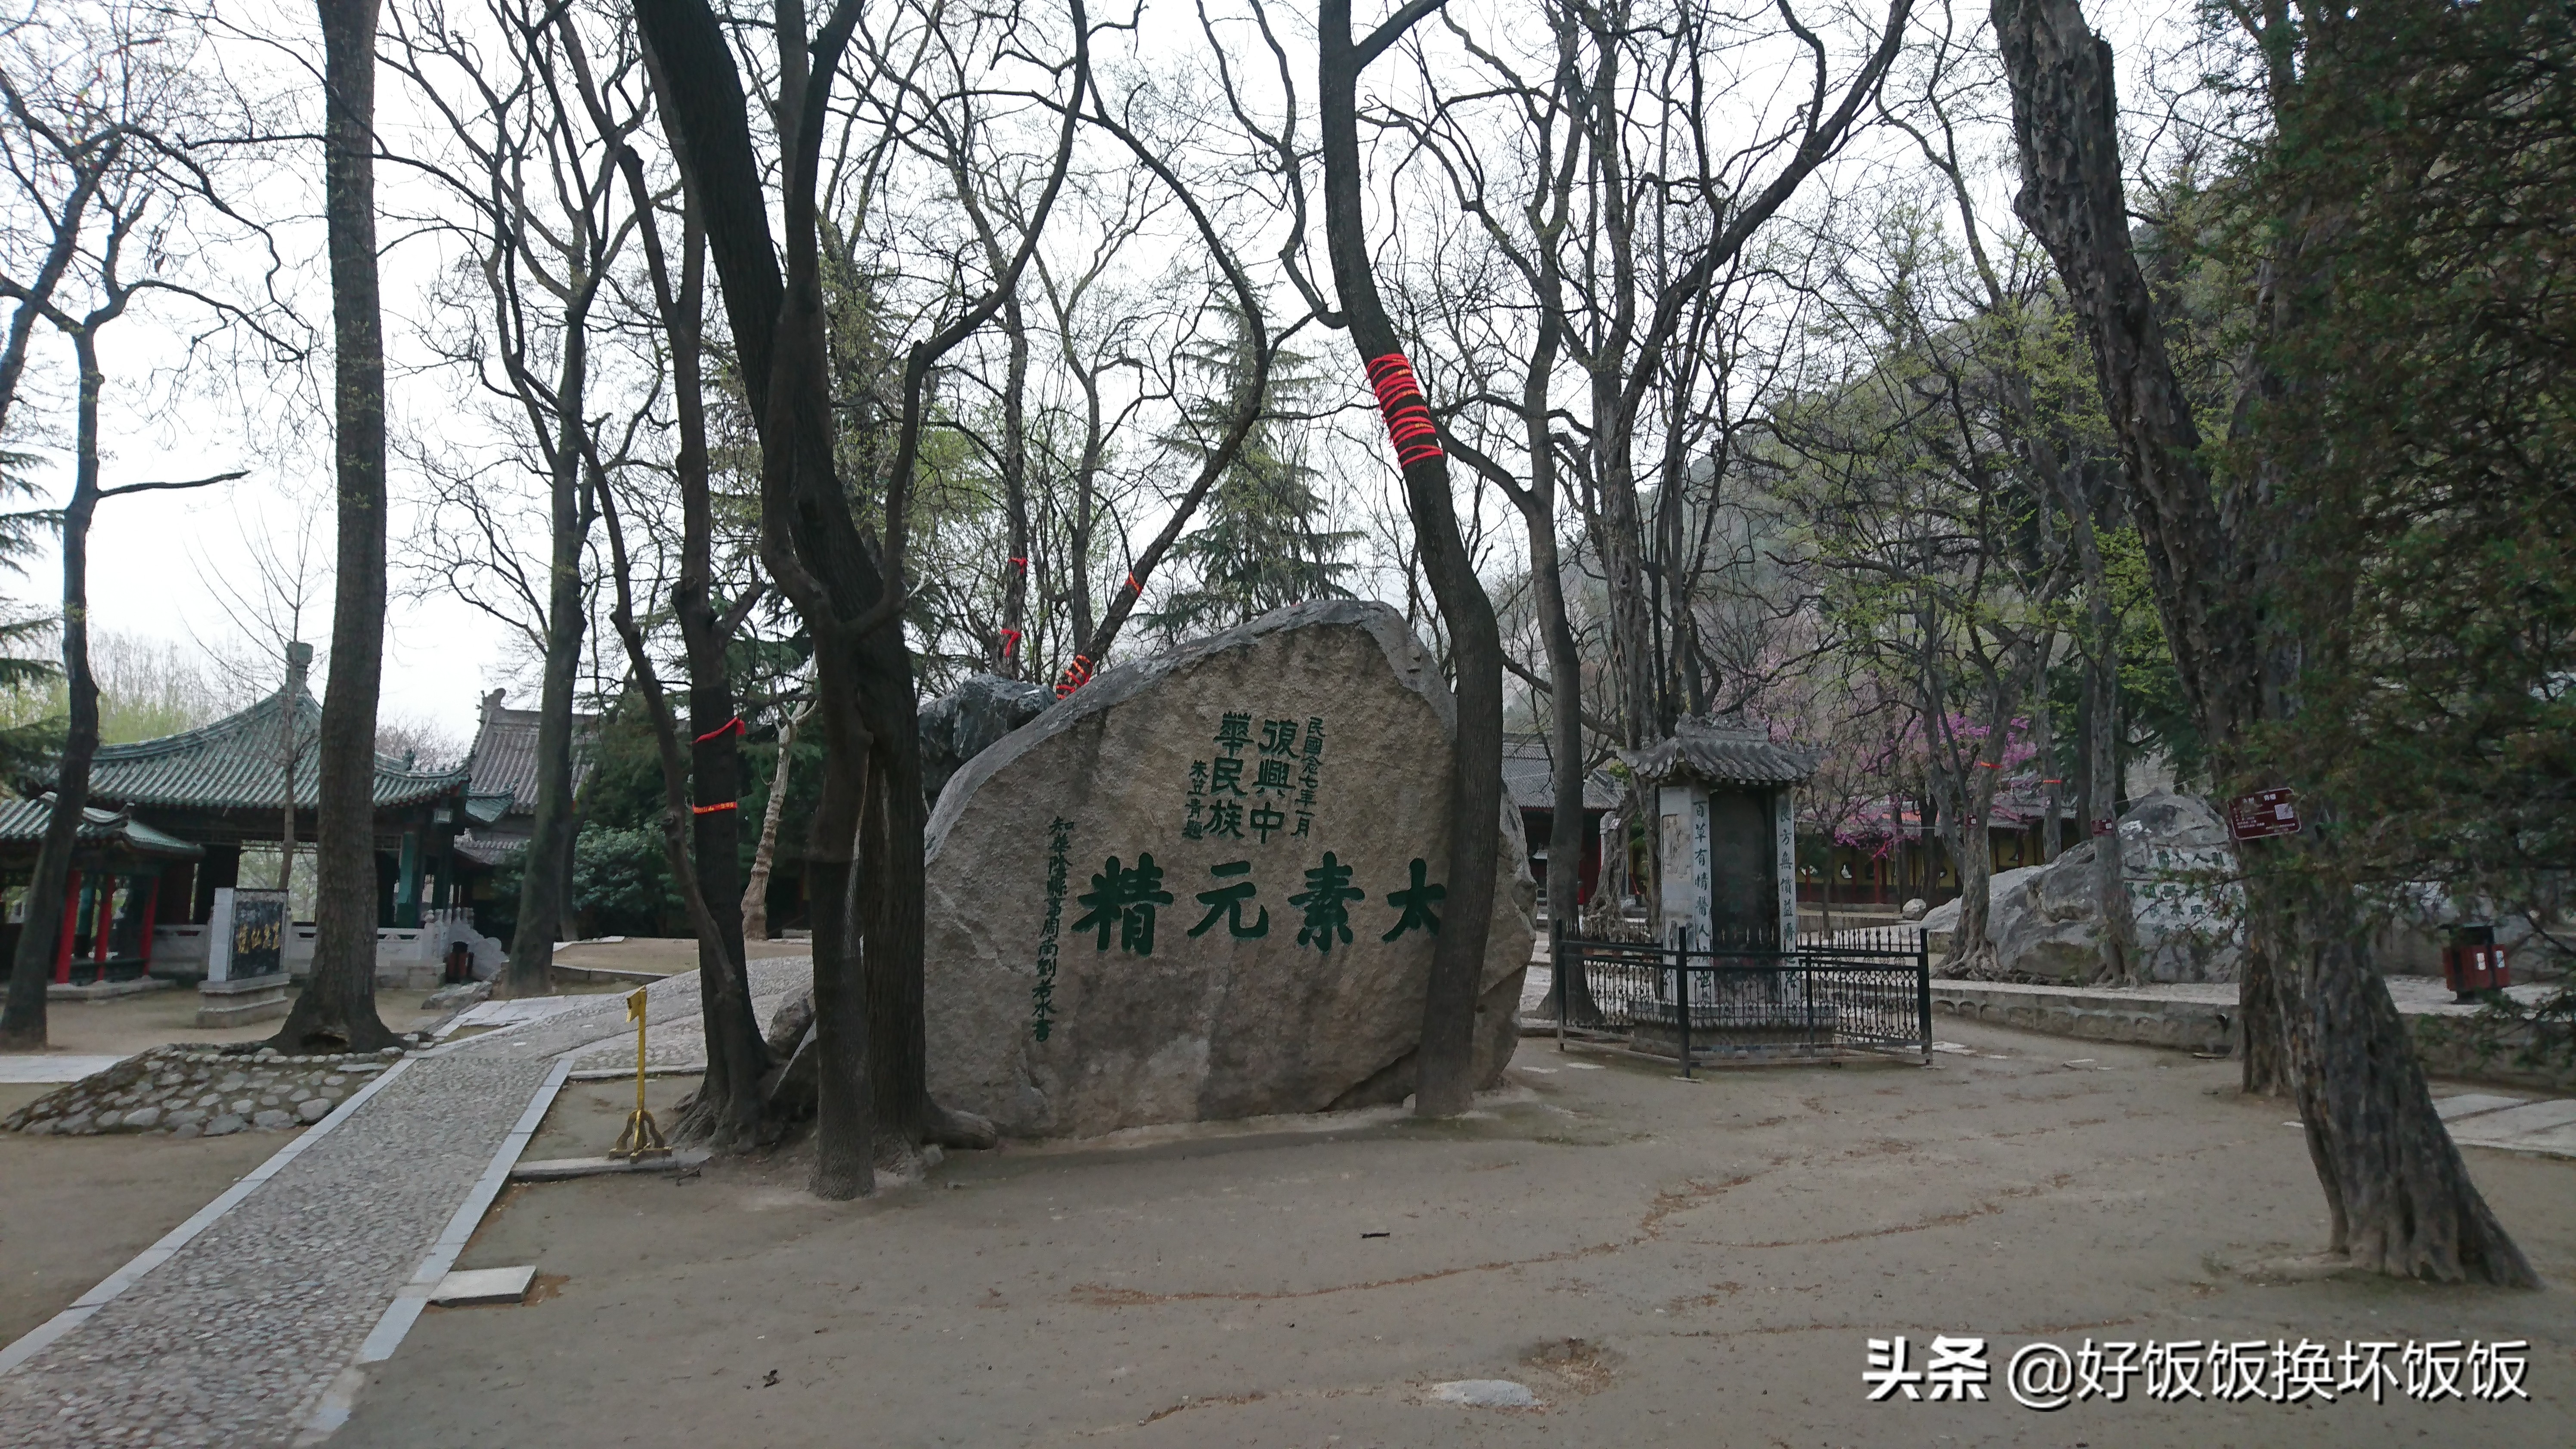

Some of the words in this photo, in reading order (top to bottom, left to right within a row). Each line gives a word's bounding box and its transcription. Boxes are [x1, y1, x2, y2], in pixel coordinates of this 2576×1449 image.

[1203, 711, 1254, 839] 華民族
[1250, 718, 1299, 845] 復興中
